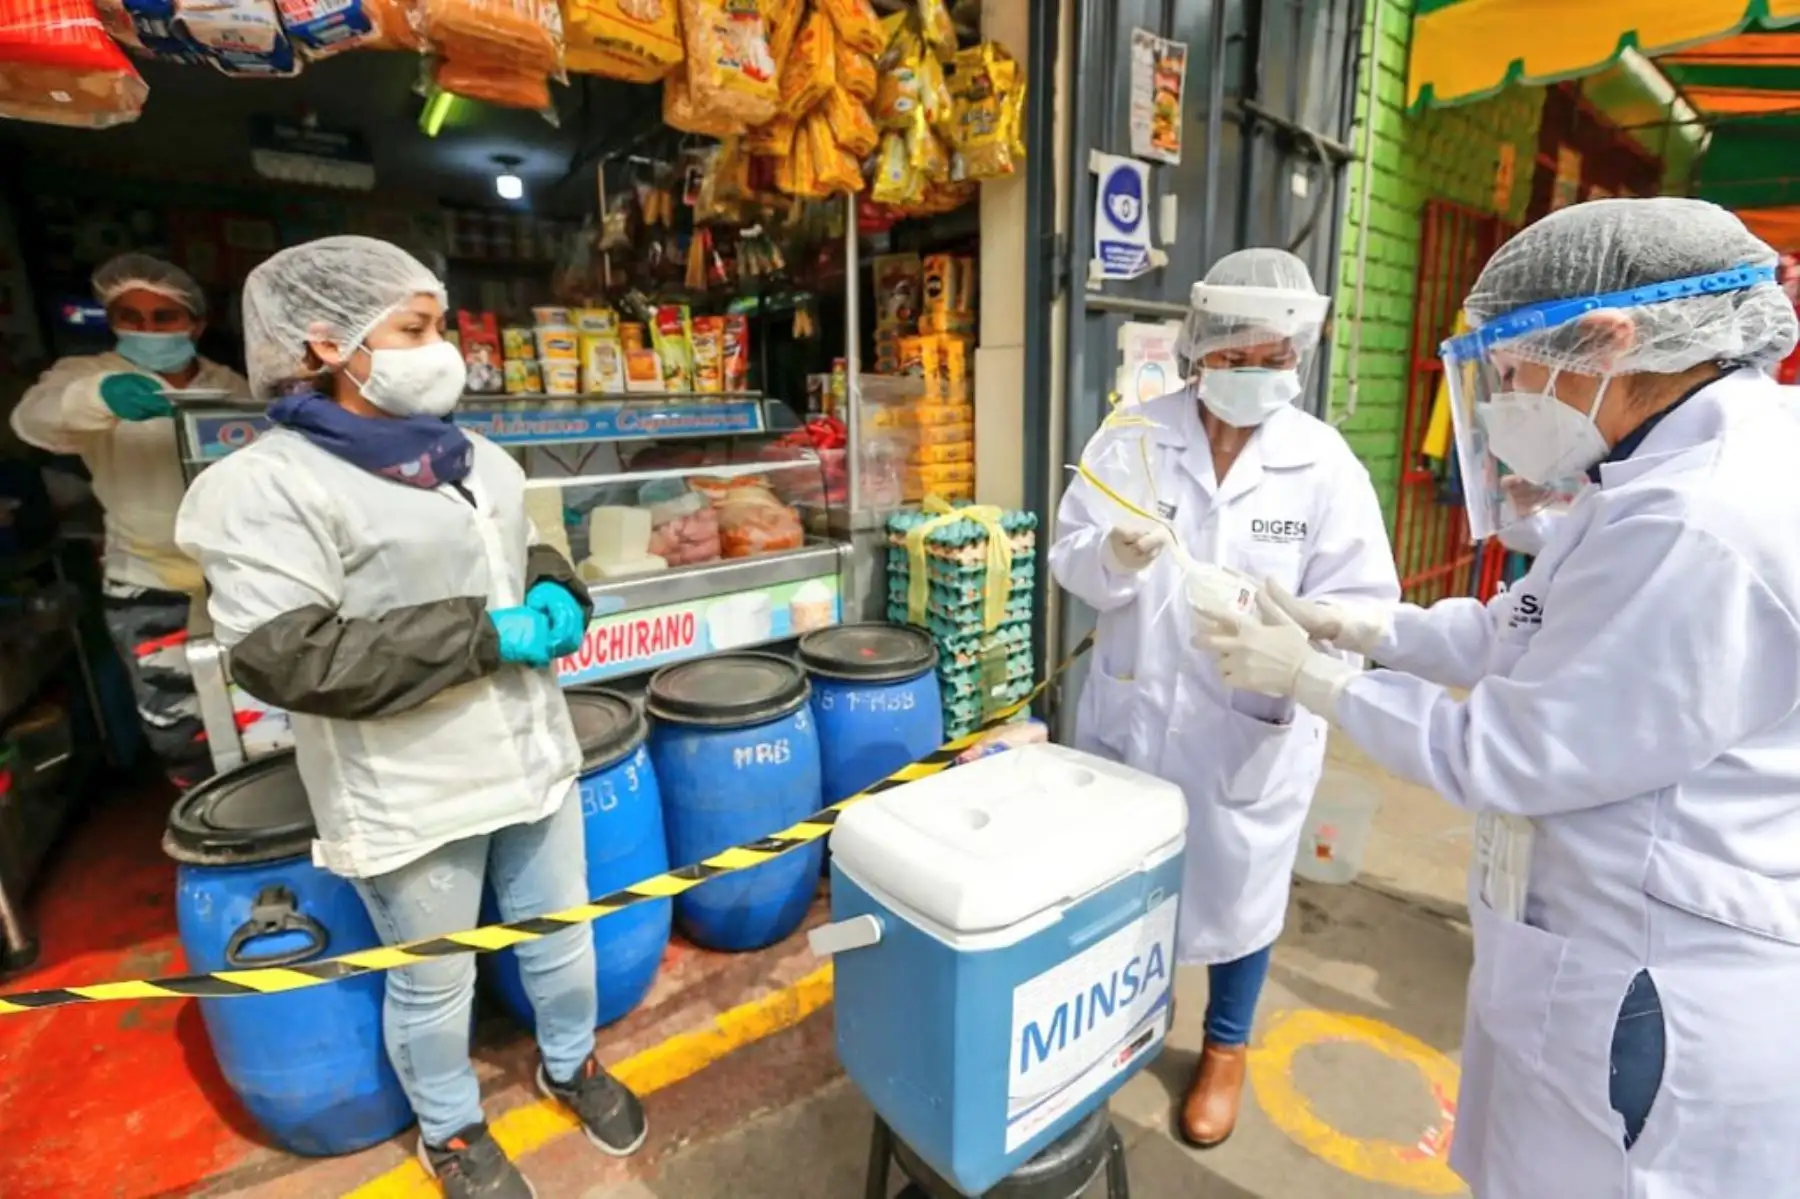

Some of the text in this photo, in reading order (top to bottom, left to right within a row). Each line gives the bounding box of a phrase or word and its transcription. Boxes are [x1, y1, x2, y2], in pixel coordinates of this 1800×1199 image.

[1251, 518, 1307, 536] DIGESA
[555, 611, 695, 674] ROCHIRANO
[1019, 941, 1165, 1076] MINSA
